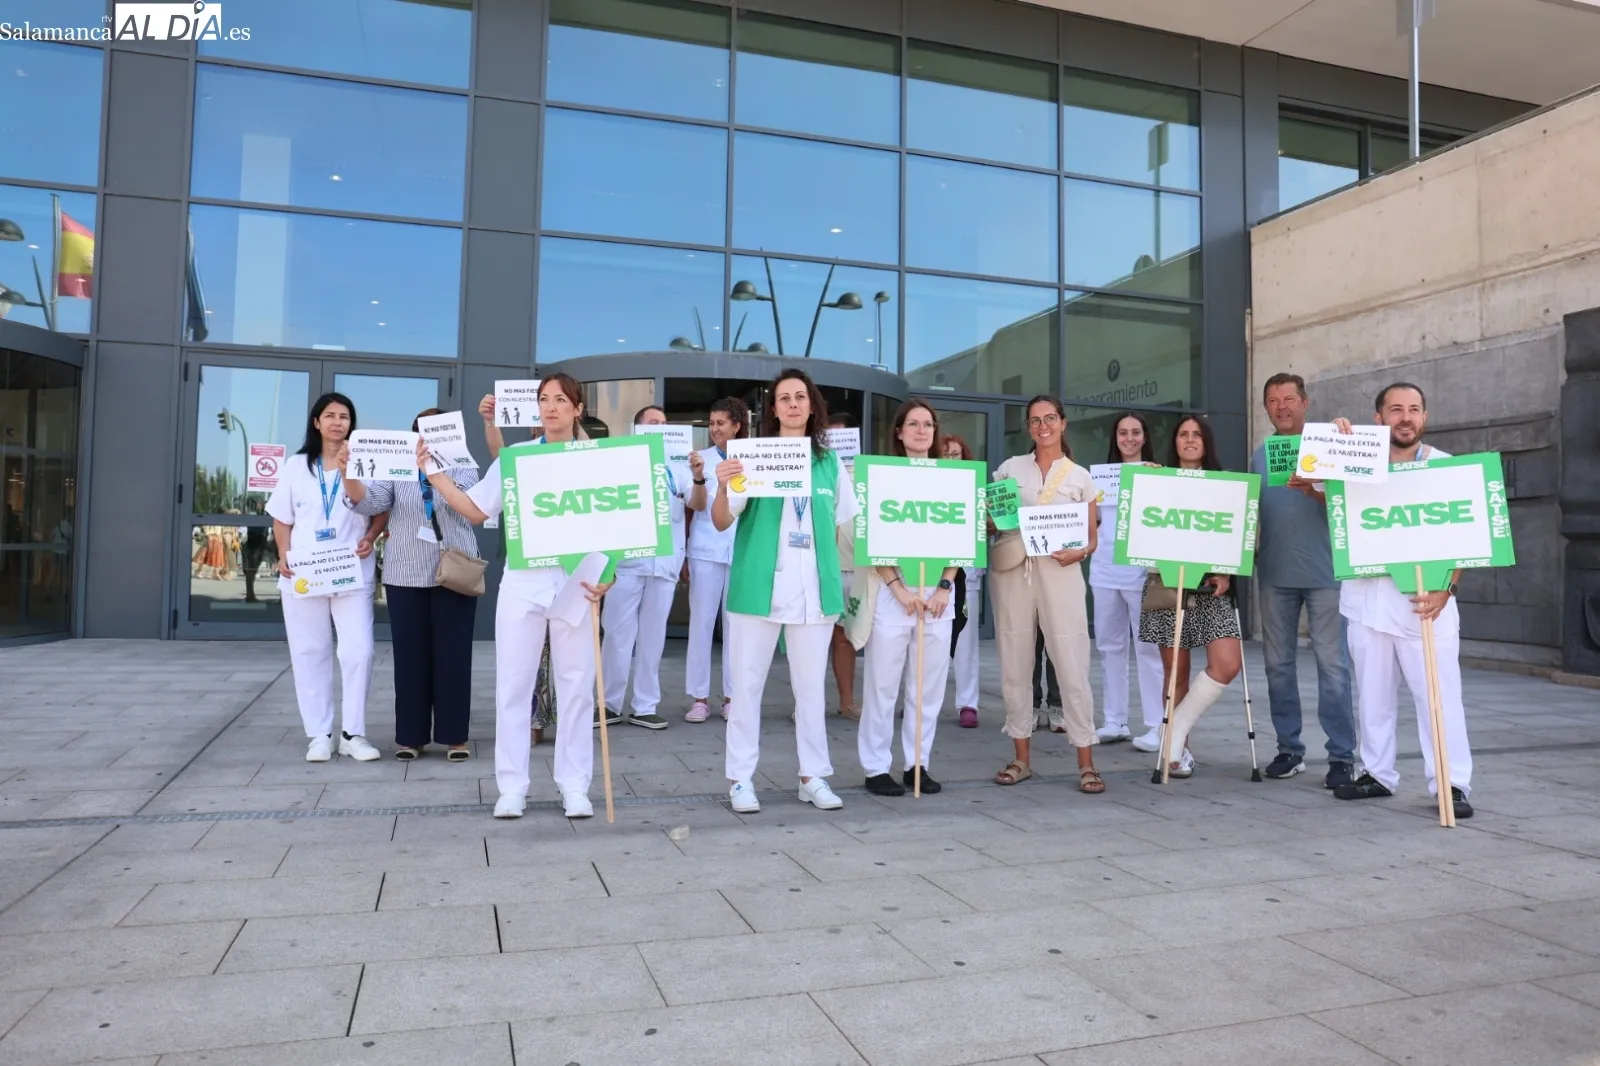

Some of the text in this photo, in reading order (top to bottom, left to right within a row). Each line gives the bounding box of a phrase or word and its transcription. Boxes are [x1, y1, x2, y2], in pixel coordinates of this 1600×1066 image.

[564, 440, 599, 450] SATSE
[910, 458, 937, 466] SATSE
[1344, 466, 1374, 475] SATSE
[1393, 460, 1429, 471] SATSE
[1176, 469, 1206, 477] SATSE
[532, 484, 641, 518] SATSE
[654, 463, 669, 526] SATSE
[504, 478, 519, 540] SATSE
[856, 482, 866, 538] SATSE
[879, 500, 966, 524] SATSE
[977, 488, 986, 541] SATSE
[1117, 489, 1130, 540] SATSE
[1360, 500, 1474, 530] SATSE
[1487, 481, 1506, 538] SATSE
[1141, 506, 1234, 534] SATSE
[1245, 499, 1258, 551] SATSE
[1332, 495, 1346, 549] SATSE
[624, 548, 656, 559] SATSE
[528, 558, 559, 568] SATSE
[1130, 558, 1156, 567] SATSE
[1211, 565, 1238, 574] SATSE
[1354, 565, 1386, 575] SATSE
[1455, 559, 1490, 568] SATSE
[332, 576, 356, 585] SATSE
